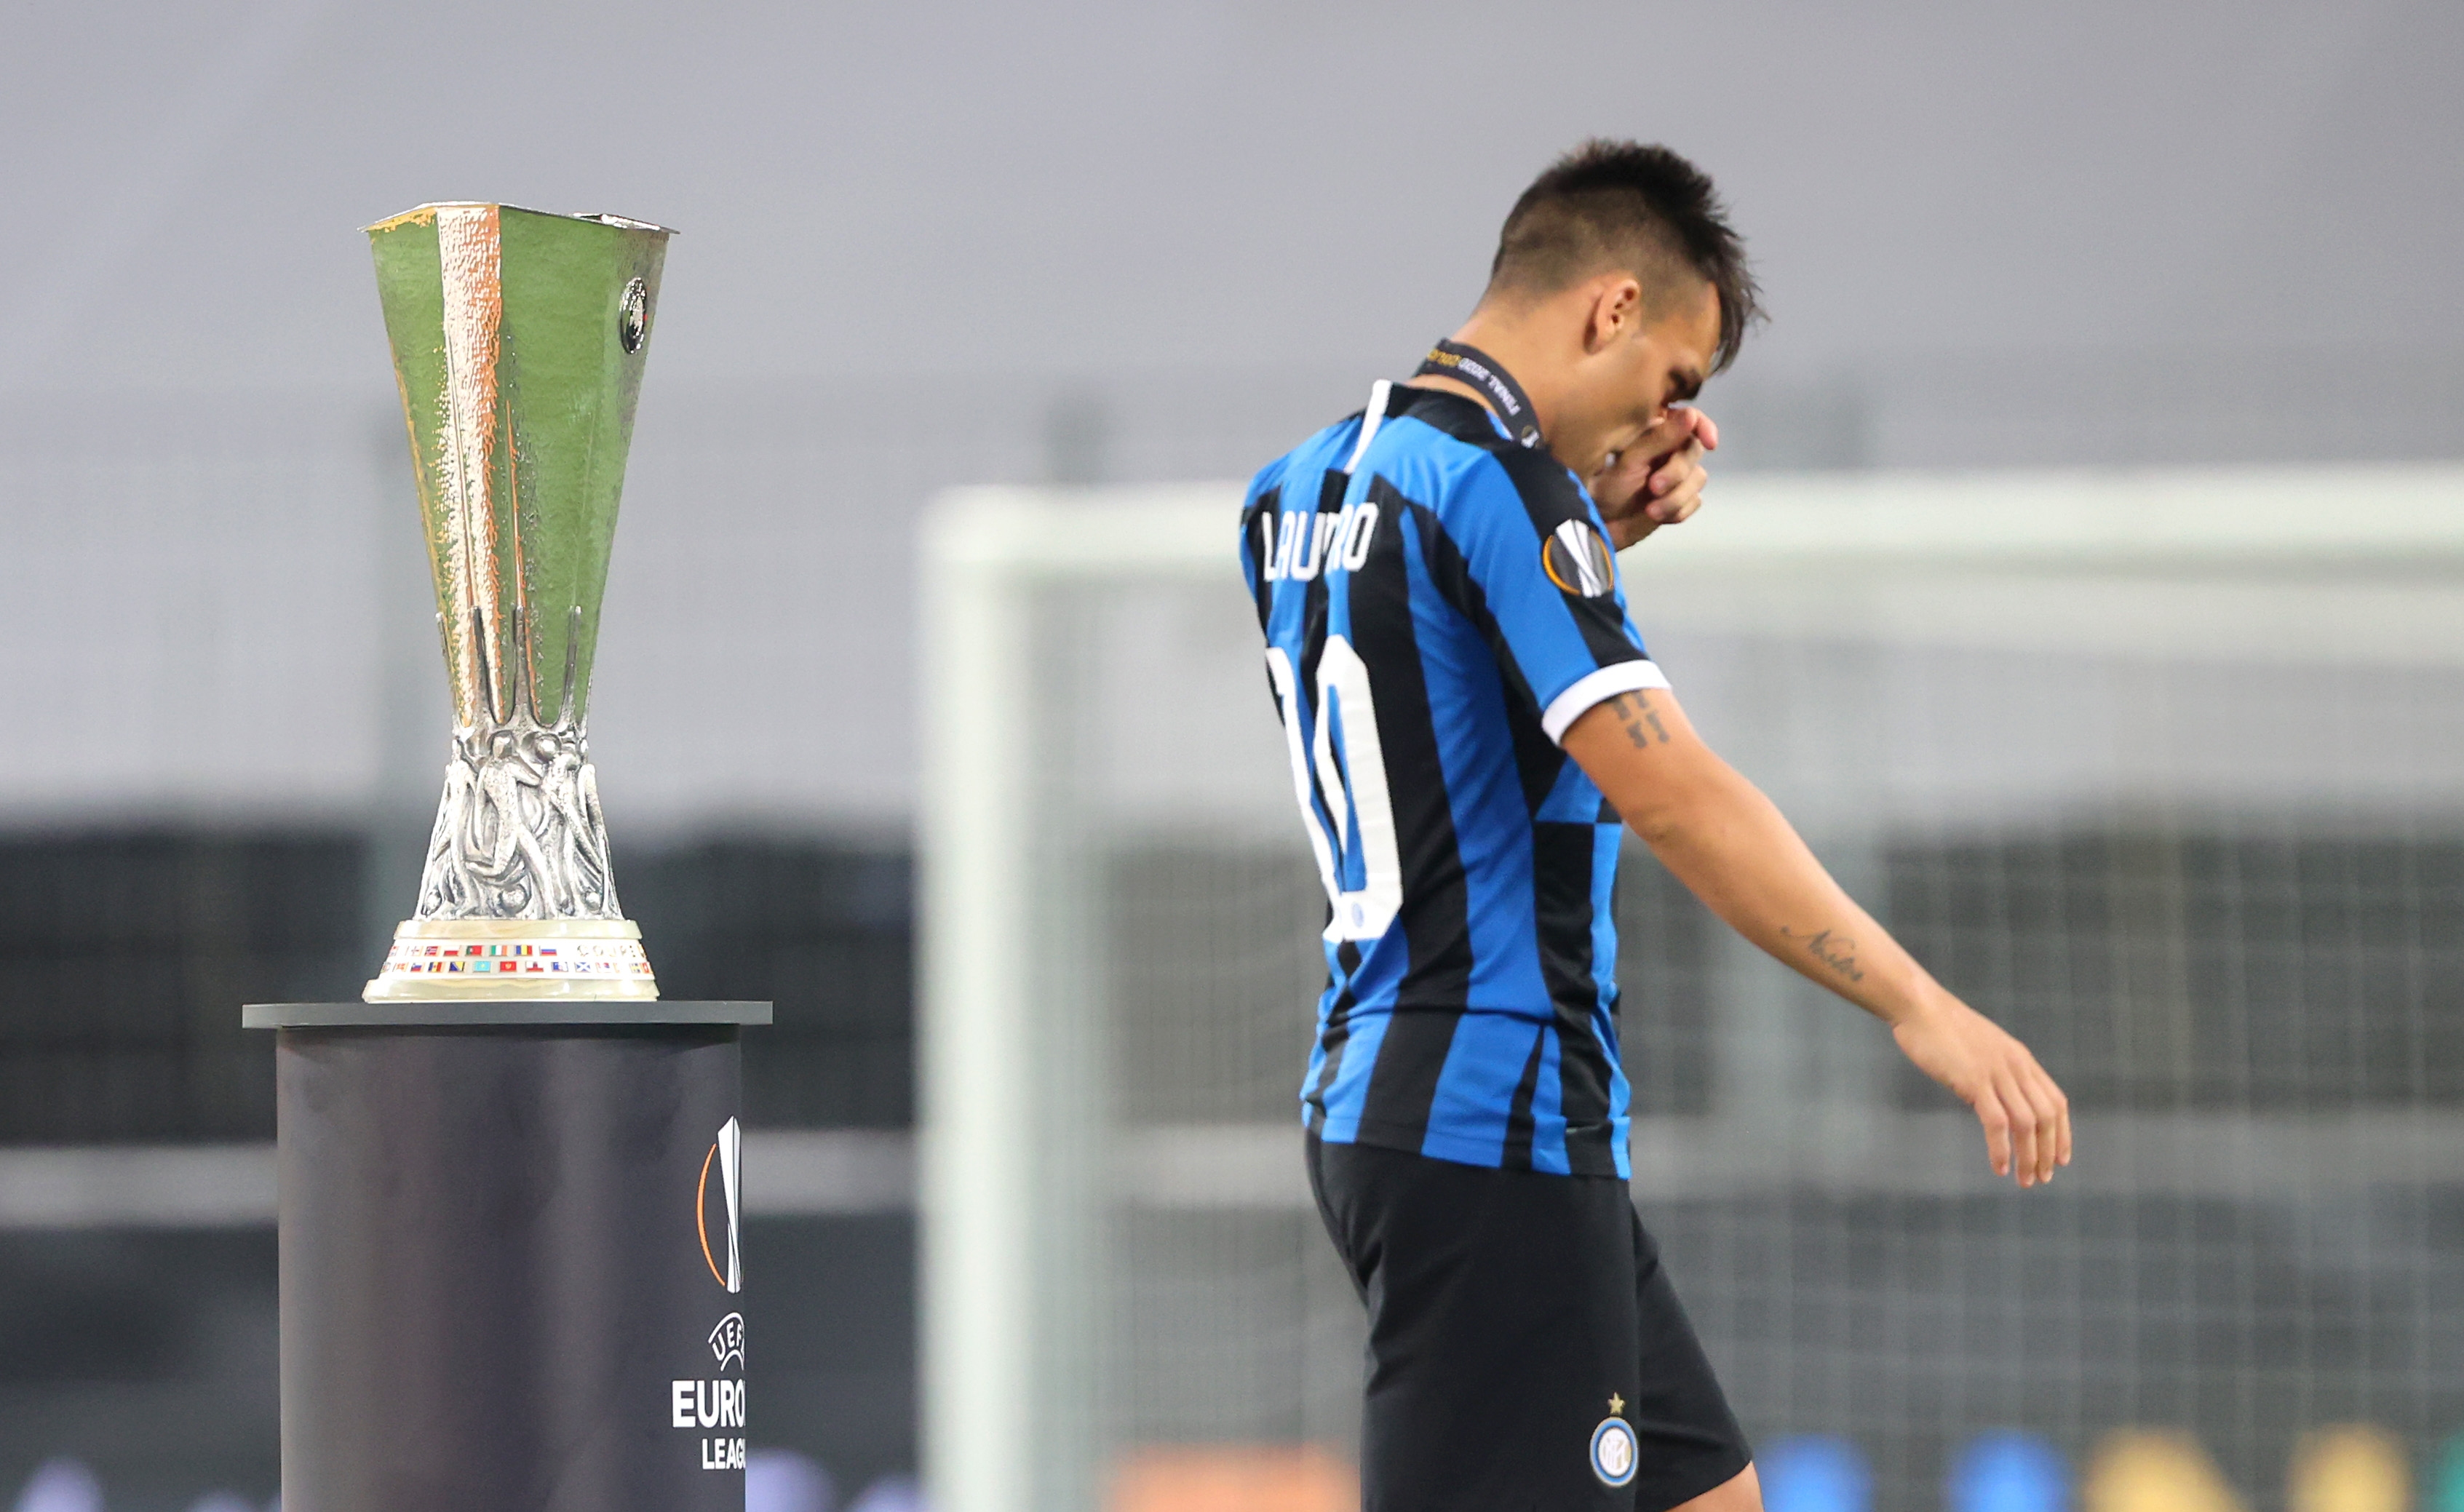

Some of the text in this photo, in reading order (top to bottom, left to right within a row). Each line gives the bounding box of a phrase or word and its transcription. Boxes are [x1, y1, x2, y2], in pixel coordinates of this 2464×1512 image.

[1265, 634, 1403, 943] 10
[712, 1321, 745, 1361] UEF
[672, 1379, 746, 1428] EURO
[702, 1438, 746, 1470] LEAG
